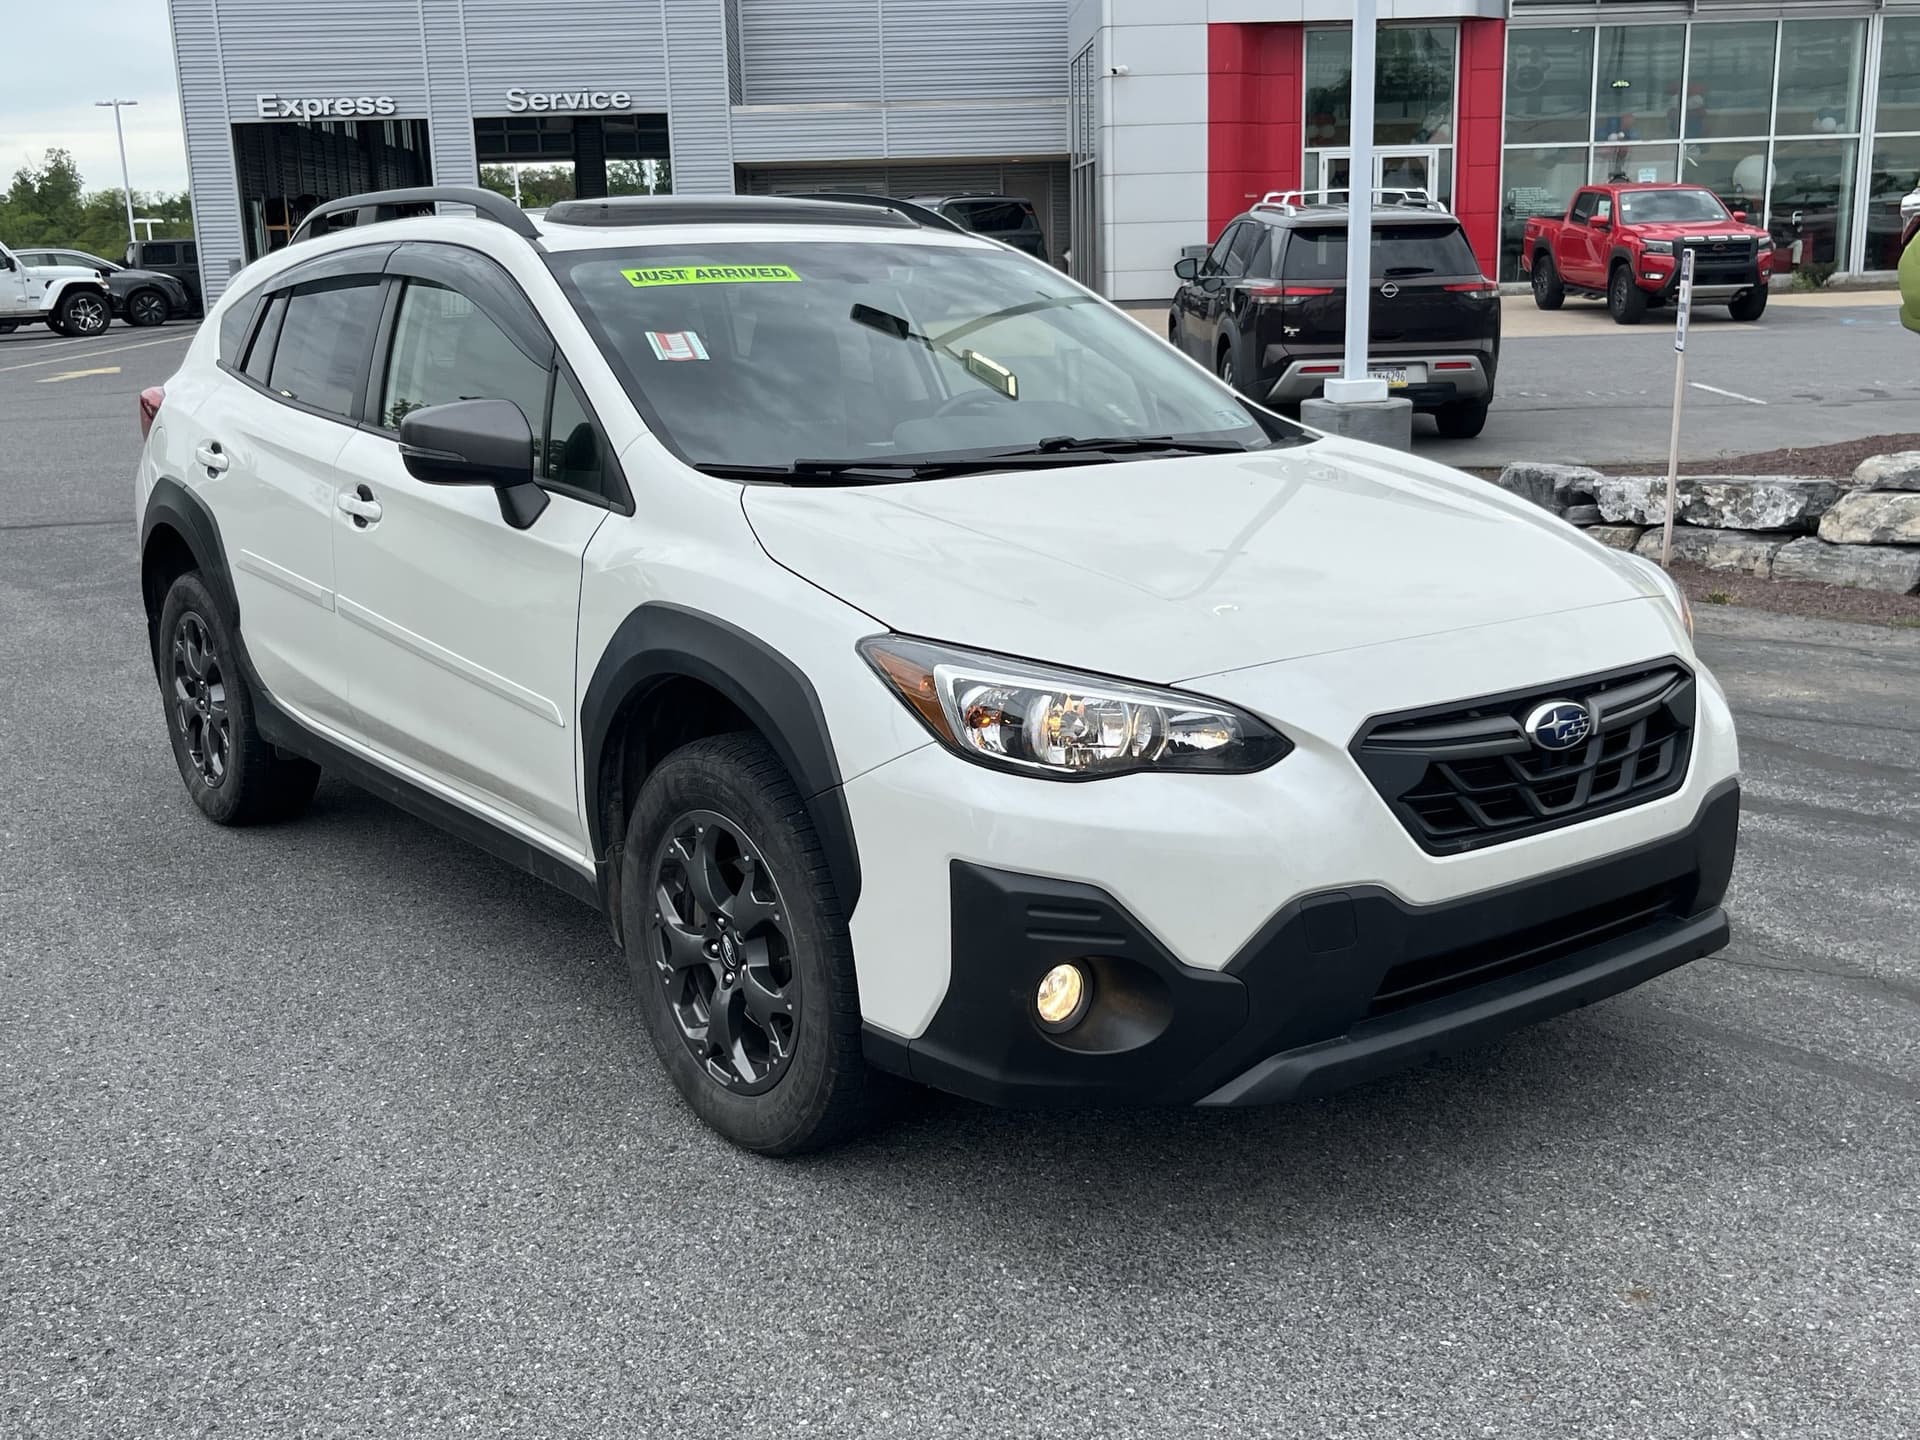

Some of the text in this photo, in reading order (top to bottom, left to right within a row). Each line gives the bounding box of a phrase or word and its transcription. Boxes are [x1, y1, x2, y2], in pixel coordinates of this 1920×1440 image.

[256, 93, 396, 122] Express
[505, 87, 632, 112] Service
[632, 267, 790, 283] JUST ARRIVED
